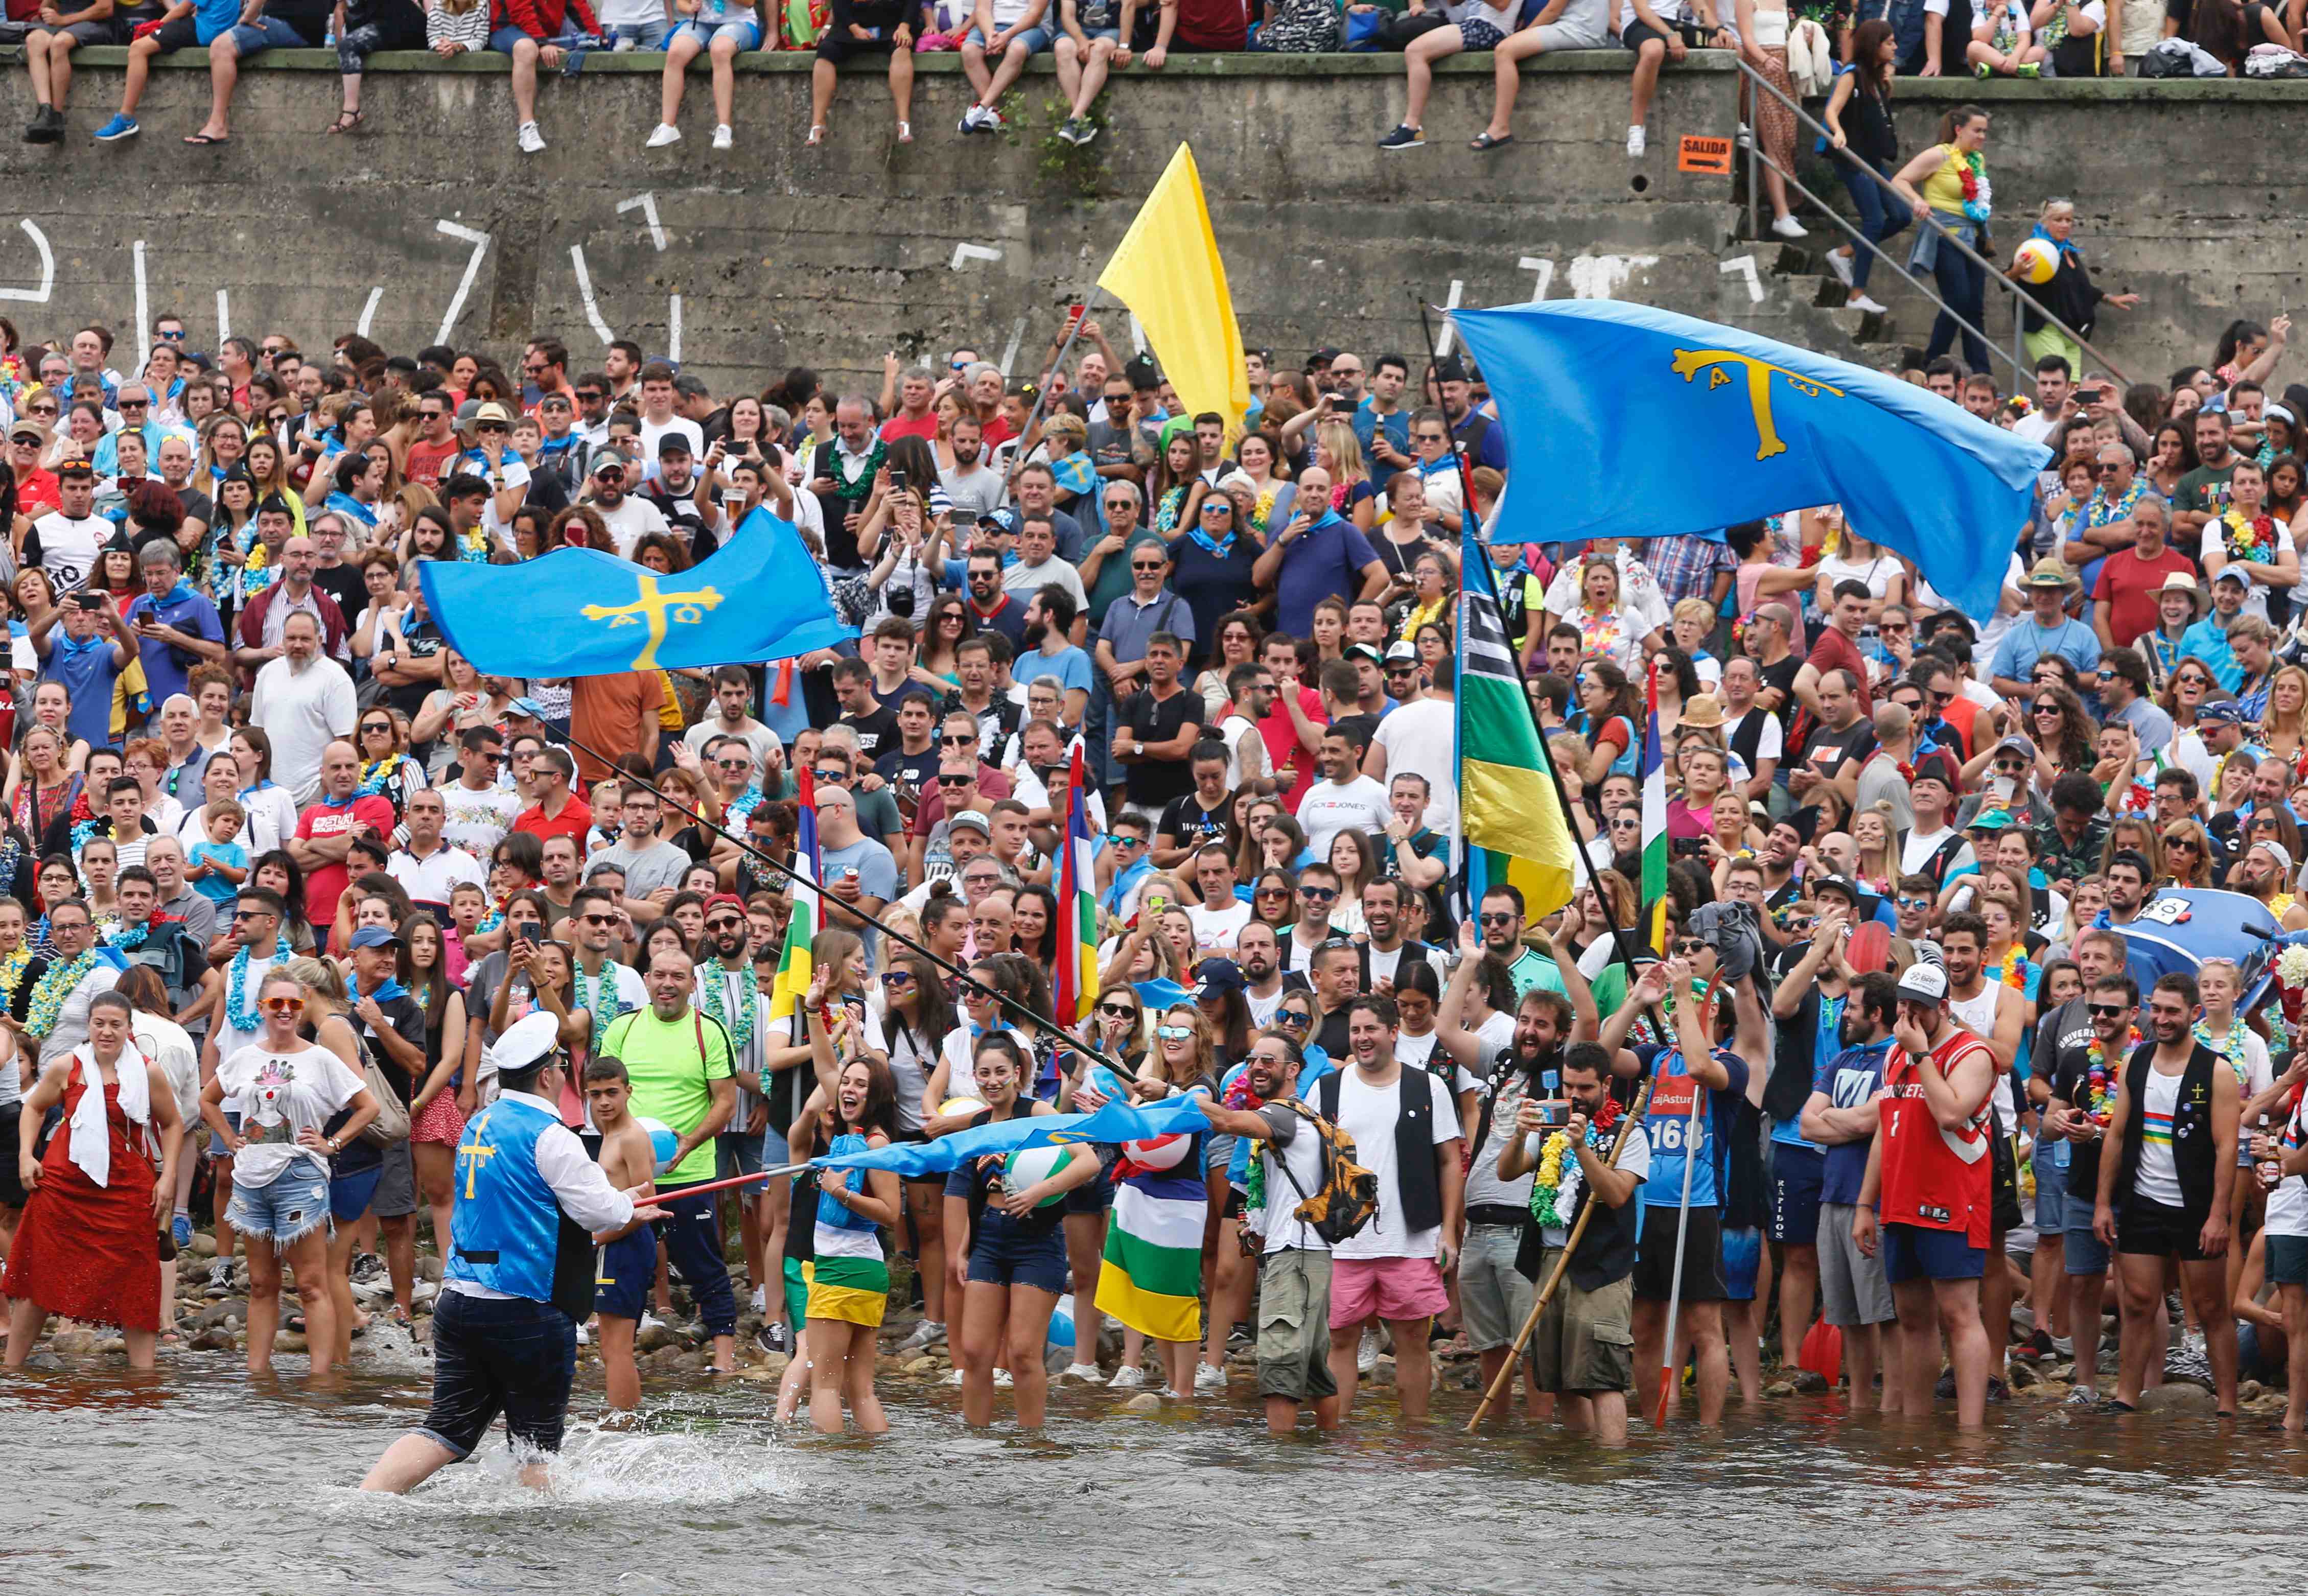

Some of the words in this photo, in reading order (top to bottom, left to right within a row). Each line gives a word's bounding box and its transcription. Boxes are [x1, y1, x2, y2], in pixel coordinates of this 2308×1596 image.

[1684, 139, 1727, 154] SALIDA
[1336, 802, 1366, 810] JONES
[1650, 1119, 1704, 1149] 168
